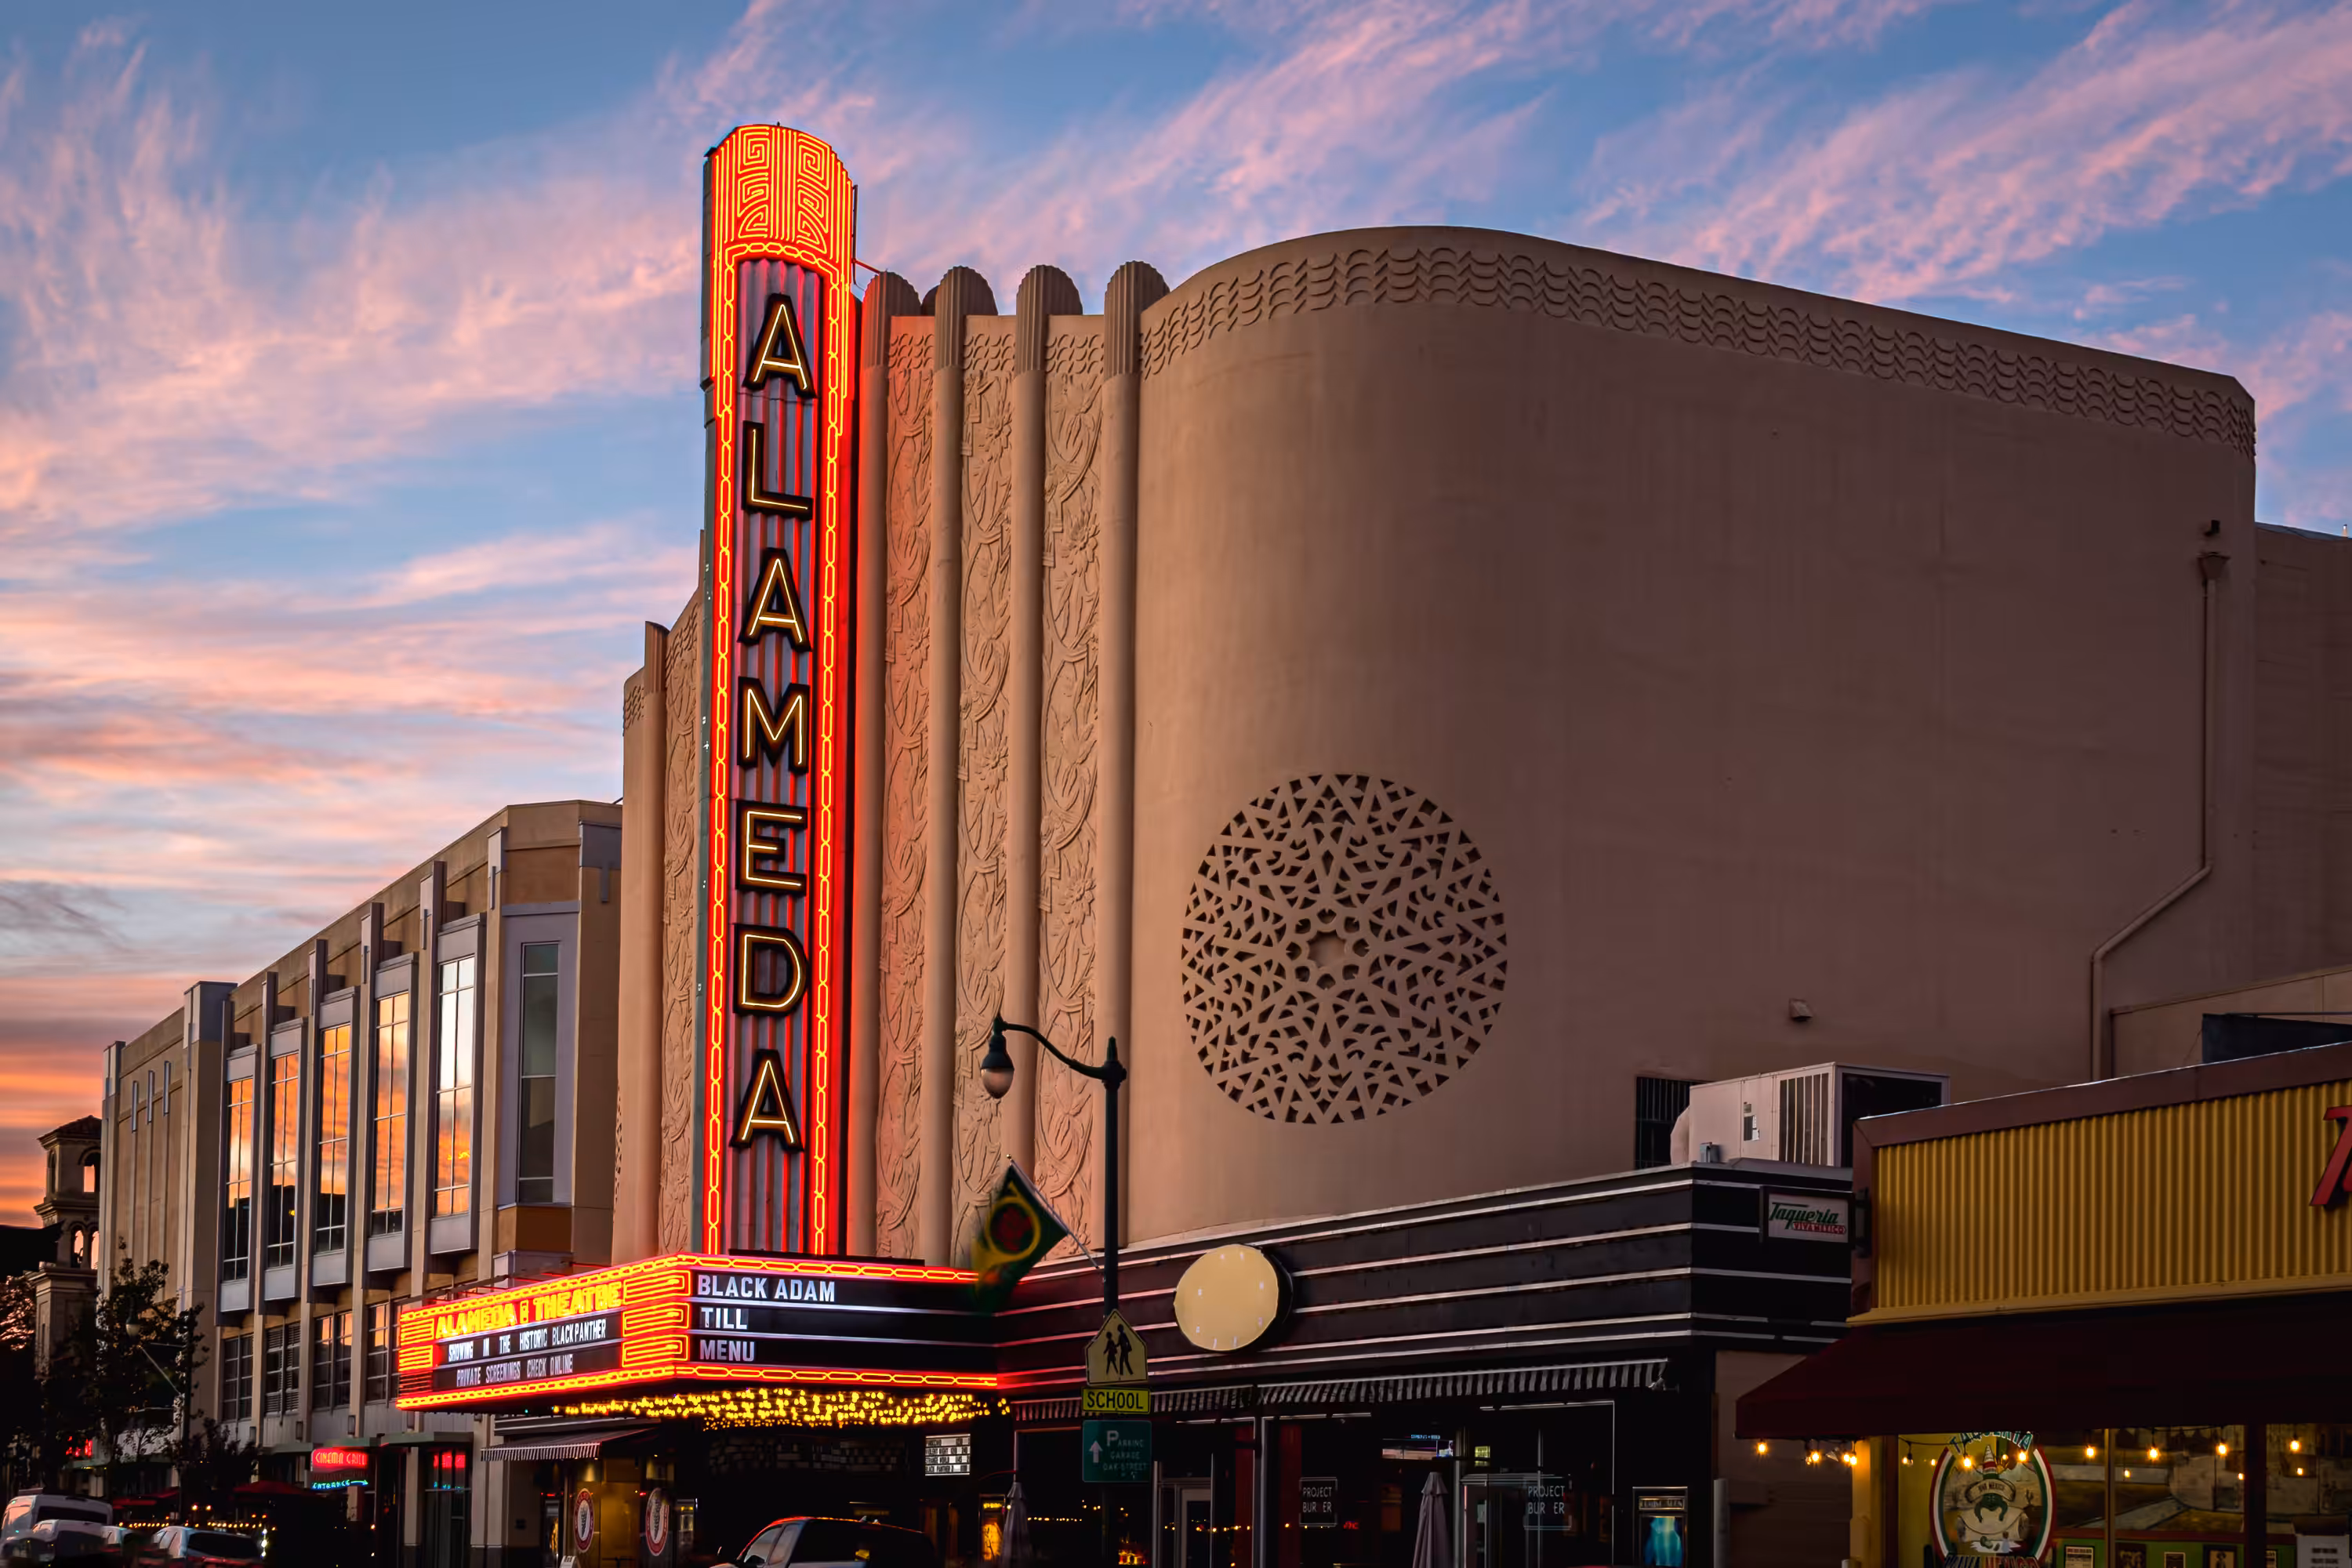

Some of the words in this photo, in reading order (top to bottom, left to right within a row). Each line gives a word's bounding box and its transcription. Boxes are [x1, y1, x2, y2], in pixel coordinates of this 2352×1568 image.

[729, 292, 817, 1152] ALAMEDA
[1769, 1202, 1839, 1230] Taqueria
[698, 1274, 768, 1299] BLACK
[774, 1279, 835, 1302] ADAM
[435, 1302, 517, 1339] ALAMEDA
[533, 1281, 622, 1321] THEATRE
[701, 1307, 748, 1330] TILL
[448, 1341, 474, 1362] SHOWING
[483, 1338, 490, 1357] IN
[499, 1334, 511, 1354] THE
[520, 1326, 548, 1352] HISTORIC
[700, 1340, 755, 1362] MENU
[456, 1367, 481, 1387] PRIVATE
[485, 1361, 521, 1384] SCREENINGS
[527, 1358, 546, 1377] CHECK
[550, 1354, 573, 1376] ONLINE
[1087, 1391, 1144, 1410] SCHOOL
[315, 1451, 344, 1465] CINEMA
[347, 1453, 365, 1465] GRILL
[1110, 1451, 1140, 1460] GARAGE
[1303, 1486, 1332, 1497] PROJECT
[1528, 1486, 1565, 1497] PROJECT
